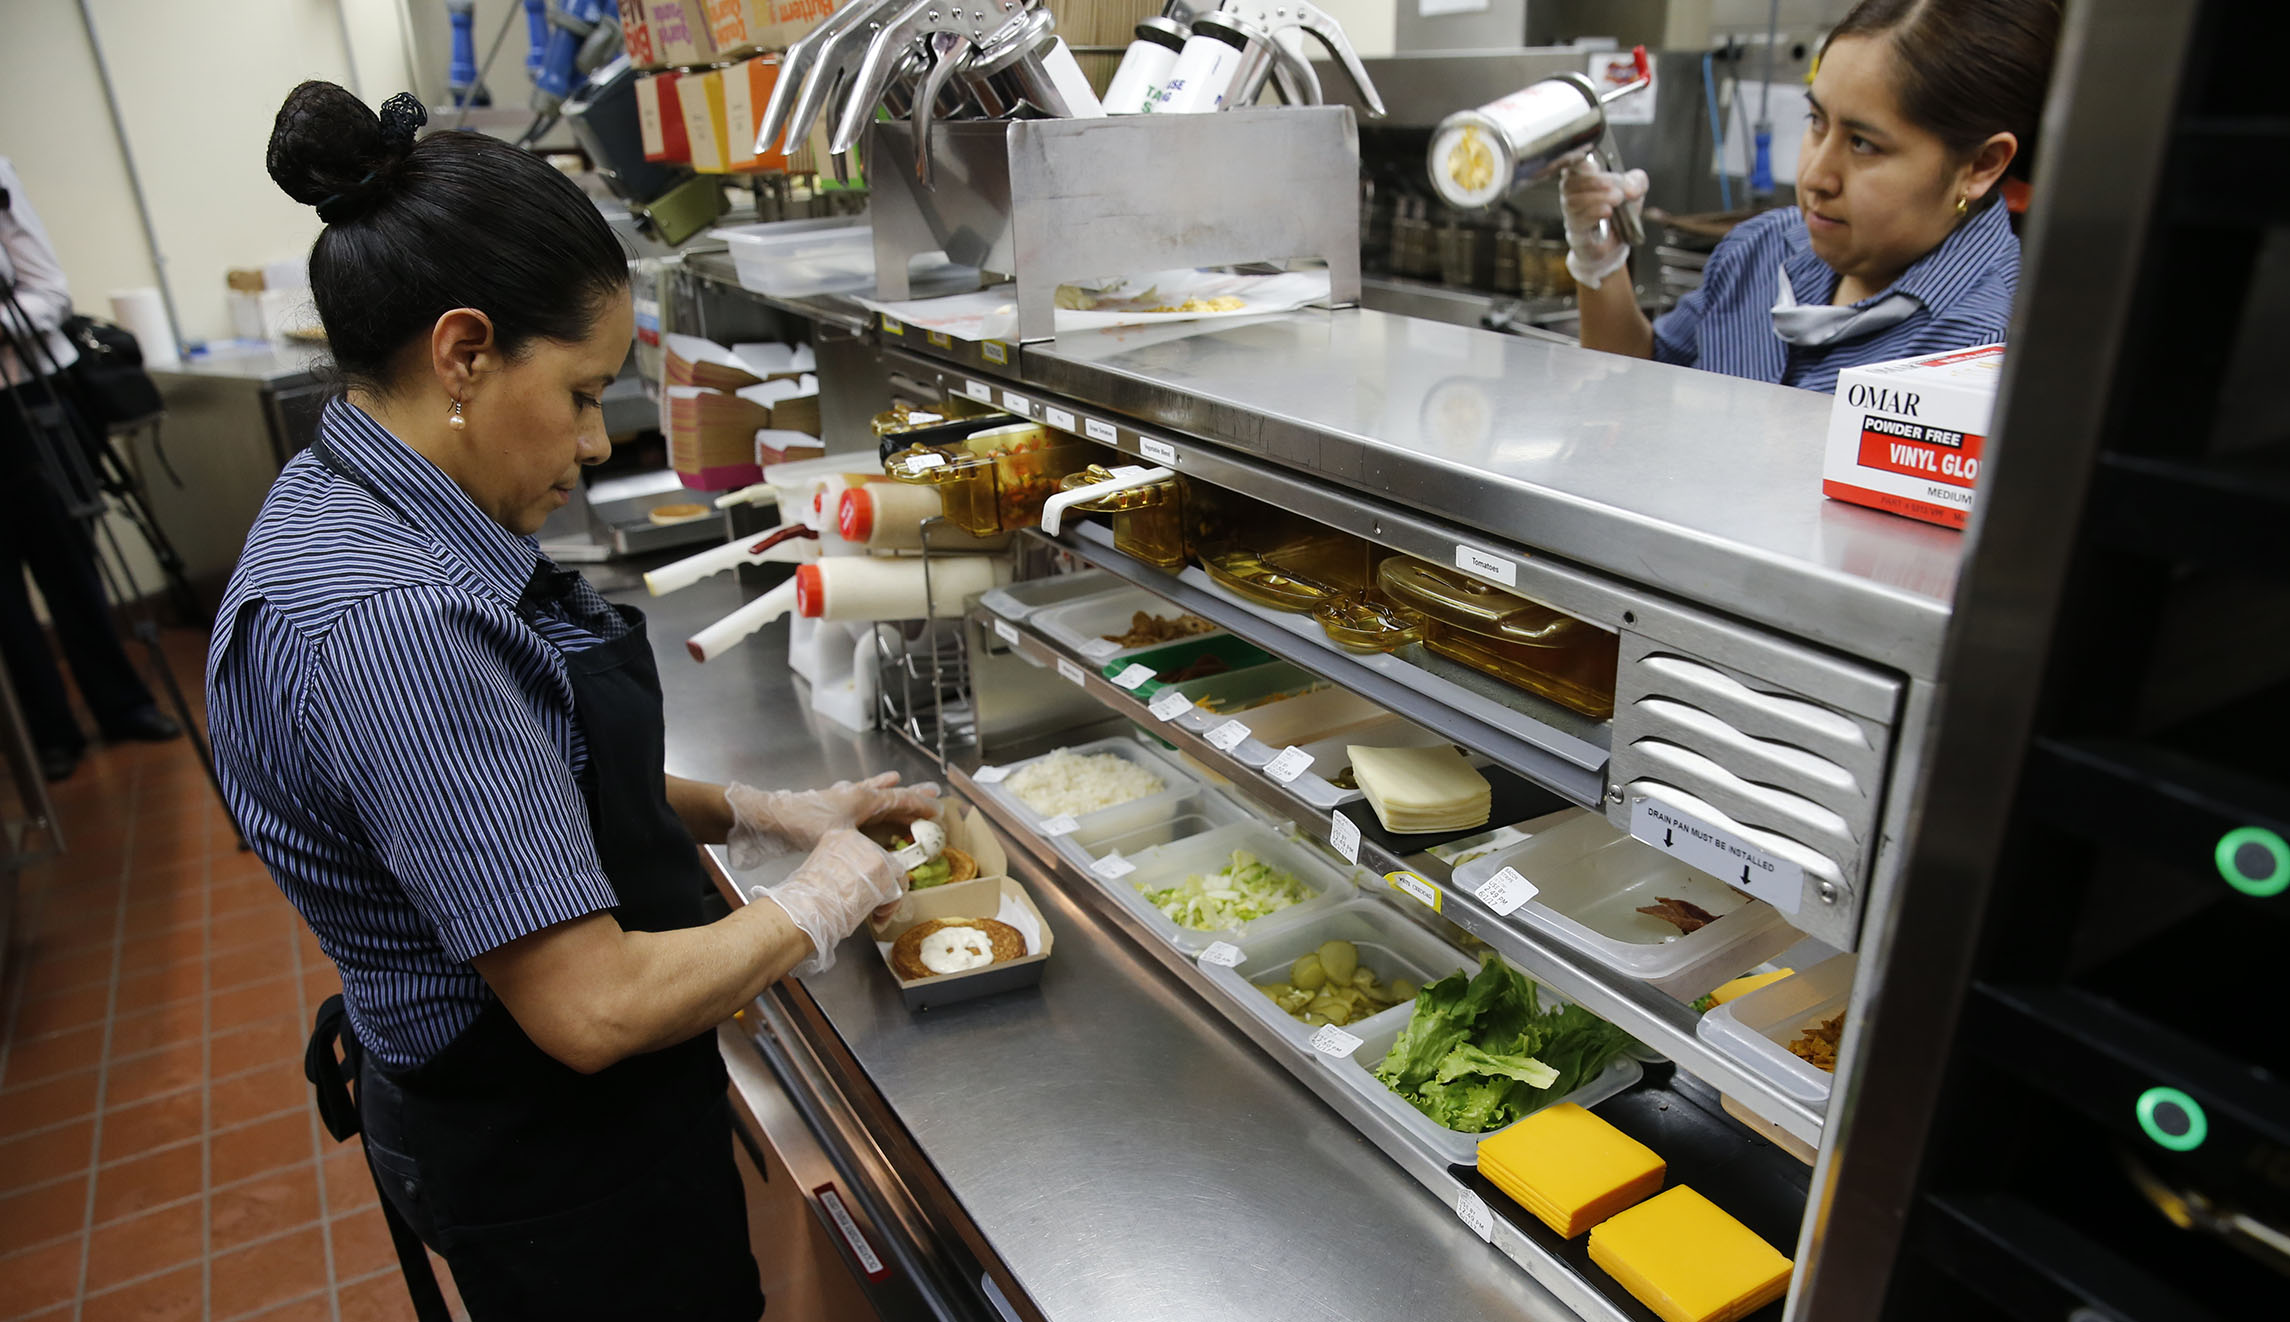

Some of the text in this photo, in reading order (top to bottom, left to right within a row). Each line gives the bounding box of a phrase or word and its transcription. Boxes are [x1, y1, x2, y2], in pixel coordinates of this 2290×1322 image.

[1848, 383, 1920, 417] OMAR
[1864, 417, 1962, 447] POWDER FREE
[1890, 443, 1981, 481] VINYL GLO
[1927, 486, 1973, 505] MEDIUM
[1471, 557, 1499, 573] Tomatoes
[1648, 807, 1775, 872] DRAIN PAN MUST BE INSTALLED
